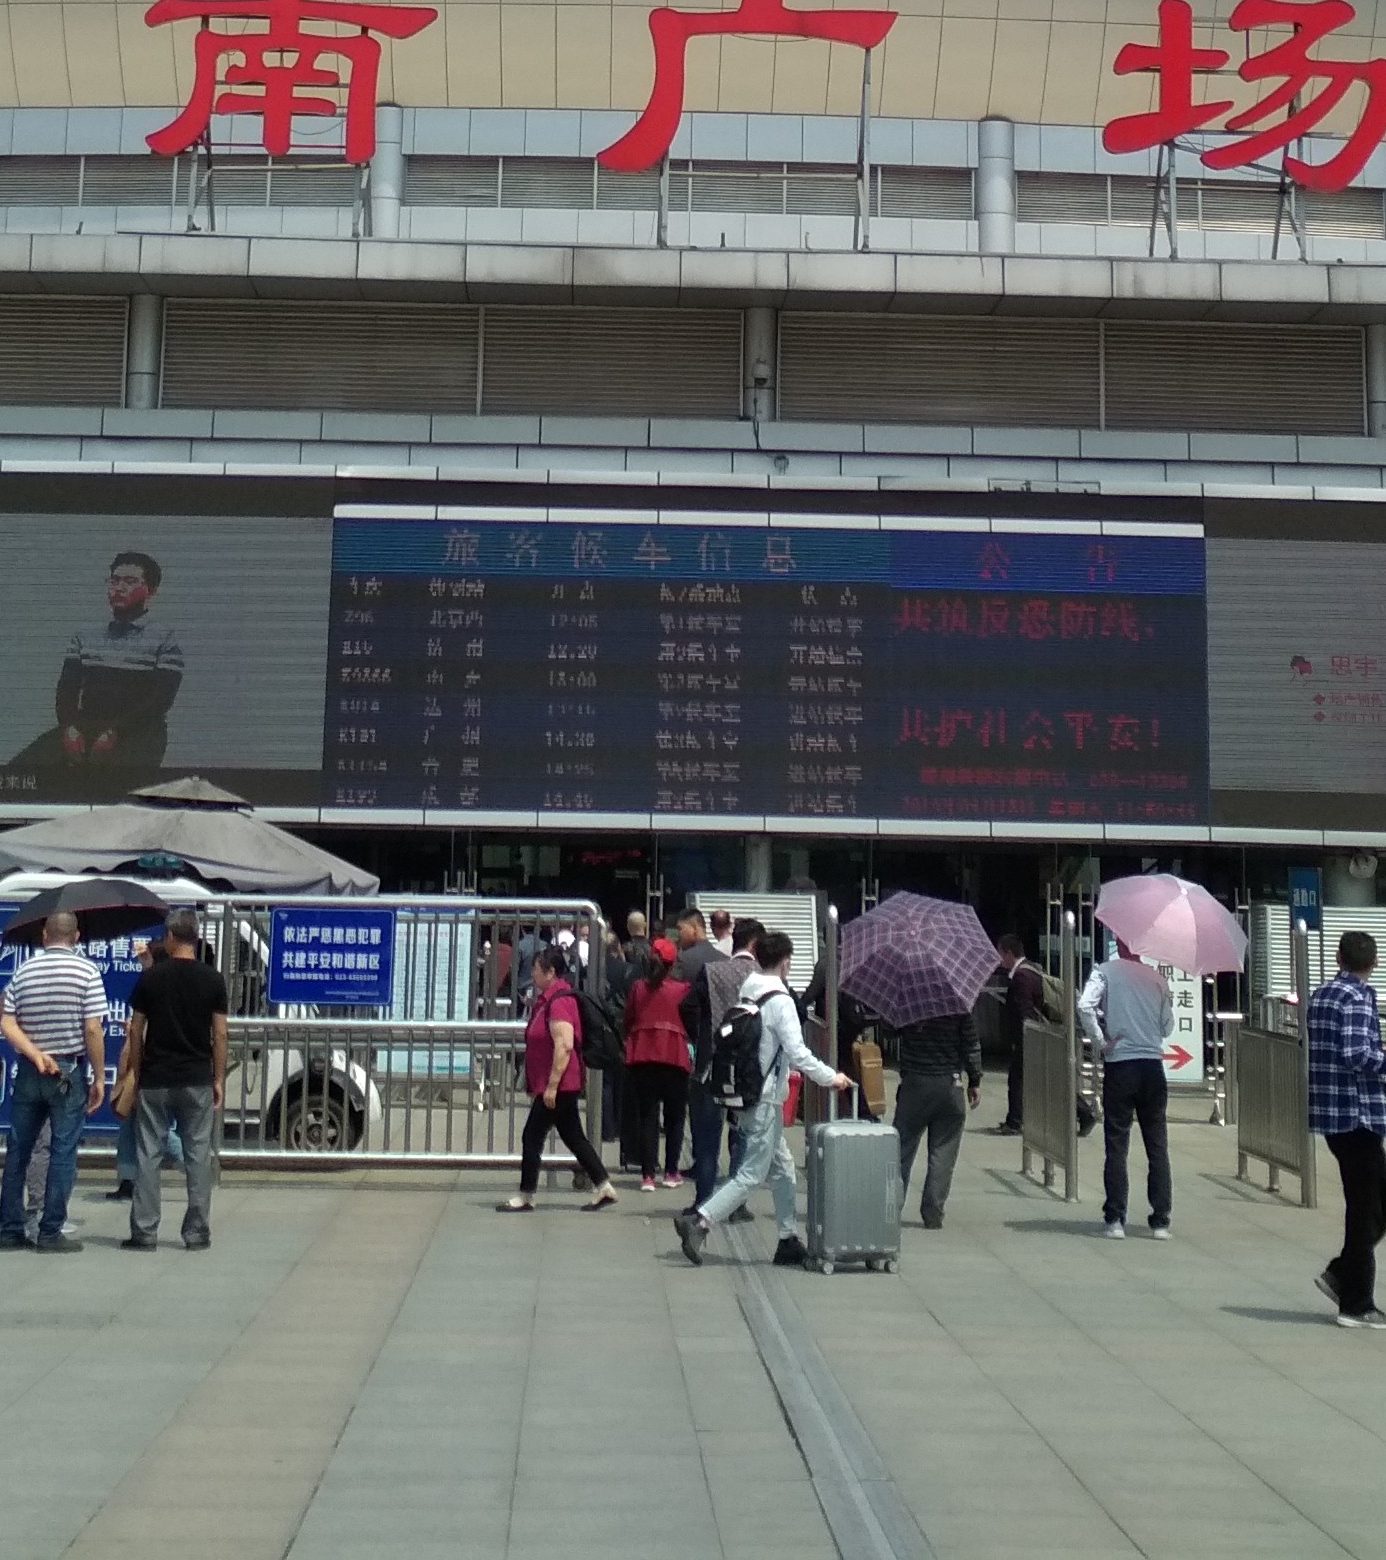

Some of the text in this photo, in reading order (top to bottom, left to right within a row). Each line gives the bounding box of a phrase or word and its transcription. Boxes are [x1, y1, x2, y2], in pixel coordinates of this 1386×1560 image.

[114, 960, 143, 973] Ticke
[282, 950, 380, 970] 共建平安和谐新区
